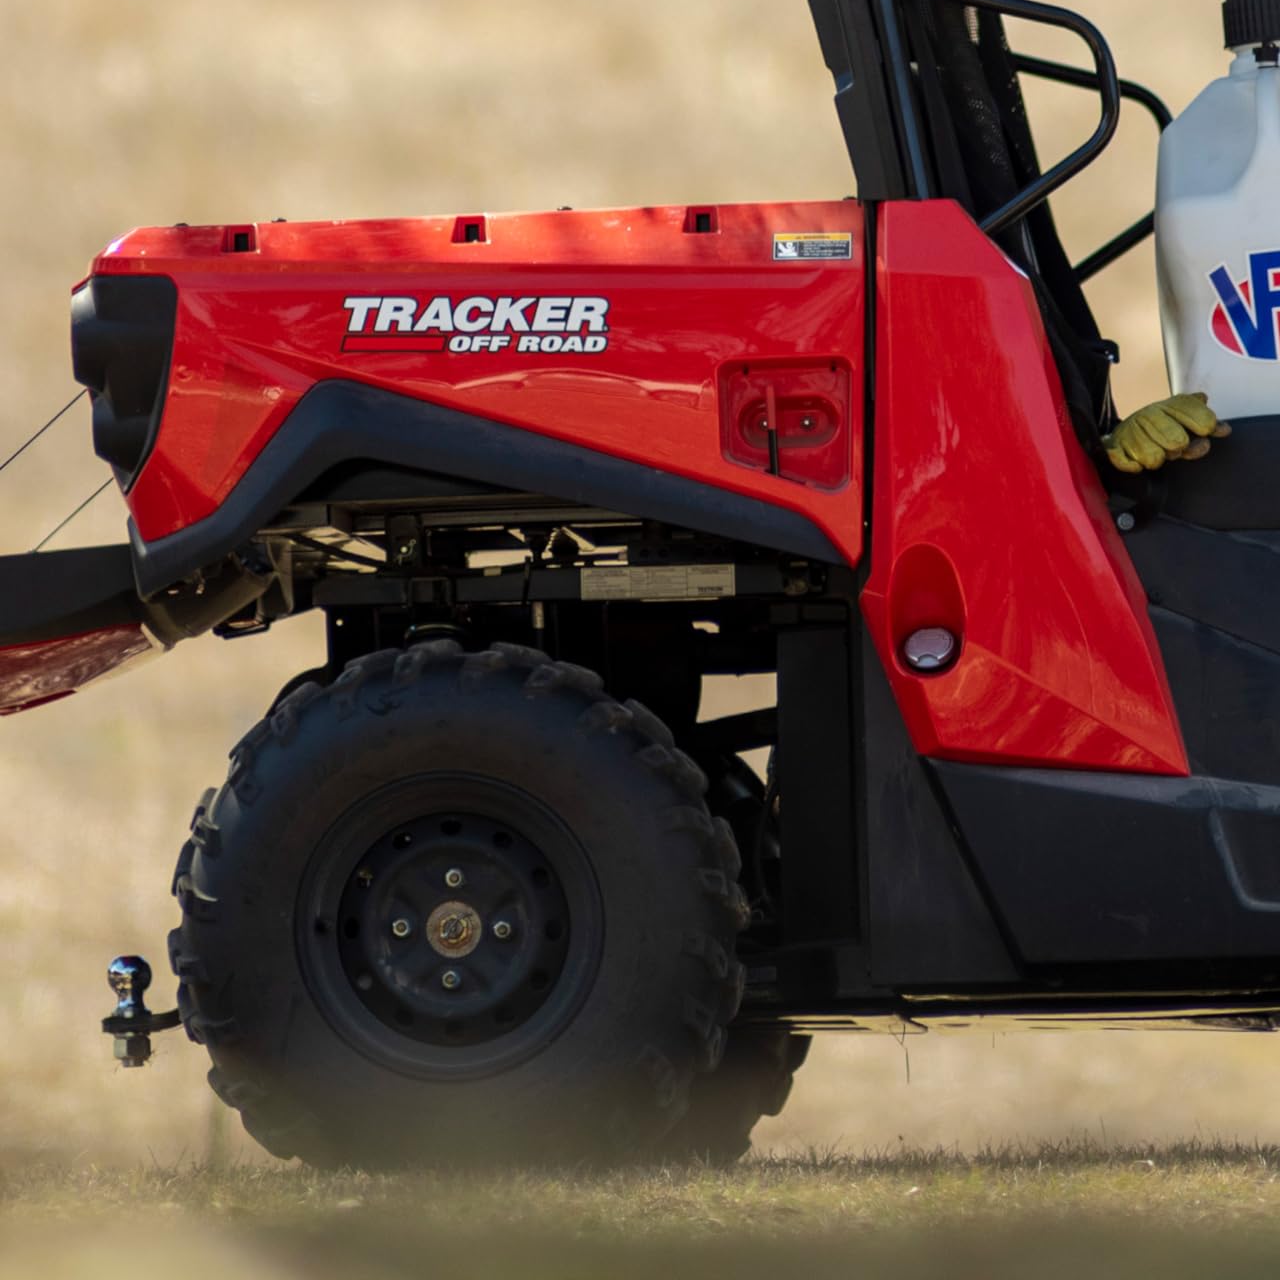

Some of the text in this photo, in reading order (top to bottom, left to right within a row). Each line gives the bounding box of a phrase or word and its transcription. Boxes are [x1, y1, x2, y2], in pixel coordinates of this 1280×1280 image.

[343, 297, 608, 332] TRACKER
[448, 336, 607, 352] OFF ROAD
